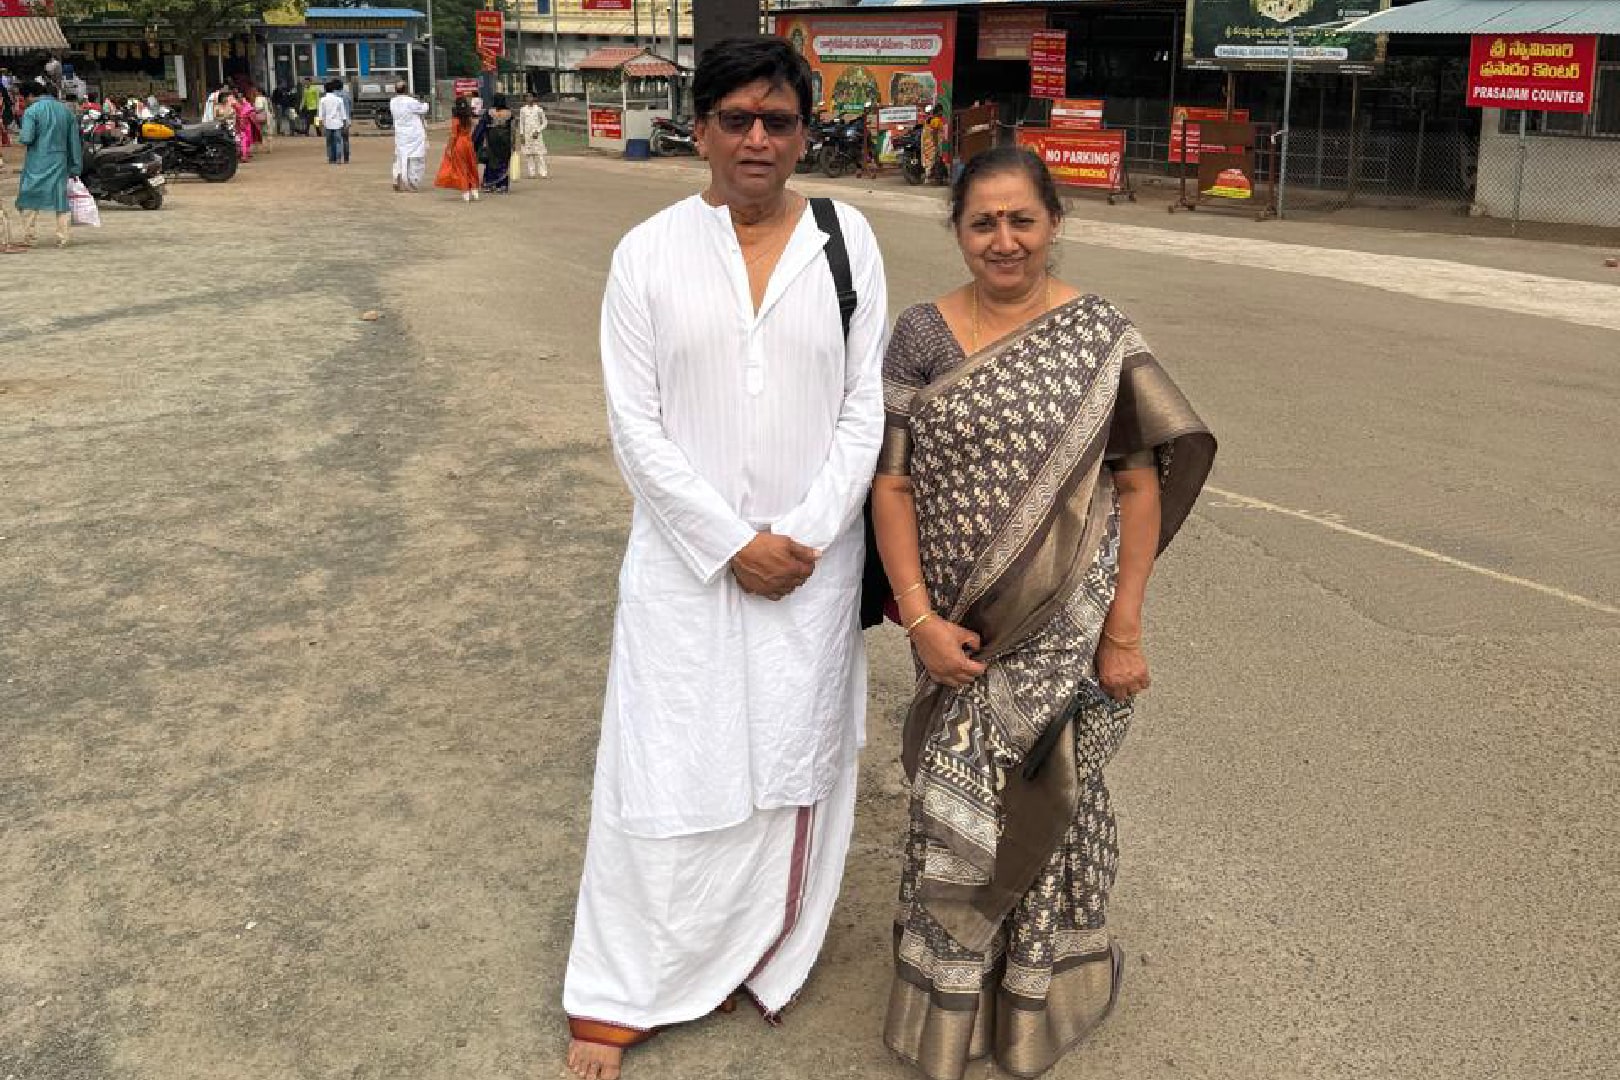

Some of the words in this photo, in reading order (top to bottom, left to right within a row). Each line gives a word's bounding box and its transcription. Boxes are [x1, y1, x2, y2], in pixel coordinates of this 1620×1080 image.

[1490, 38, 1505, 58] శ్రీ
[1509, 40, 1574, 60] స్వామివారి
[1481, 61, 1530, 77] ప్రసాదం
[1473, 86, 1530, 101] PRASADAM
[1531, 89, 1584, 103] COUNTER
[1045, 149, 1061, 162] NO
[1062, 150, 1110, 165] PARKING
